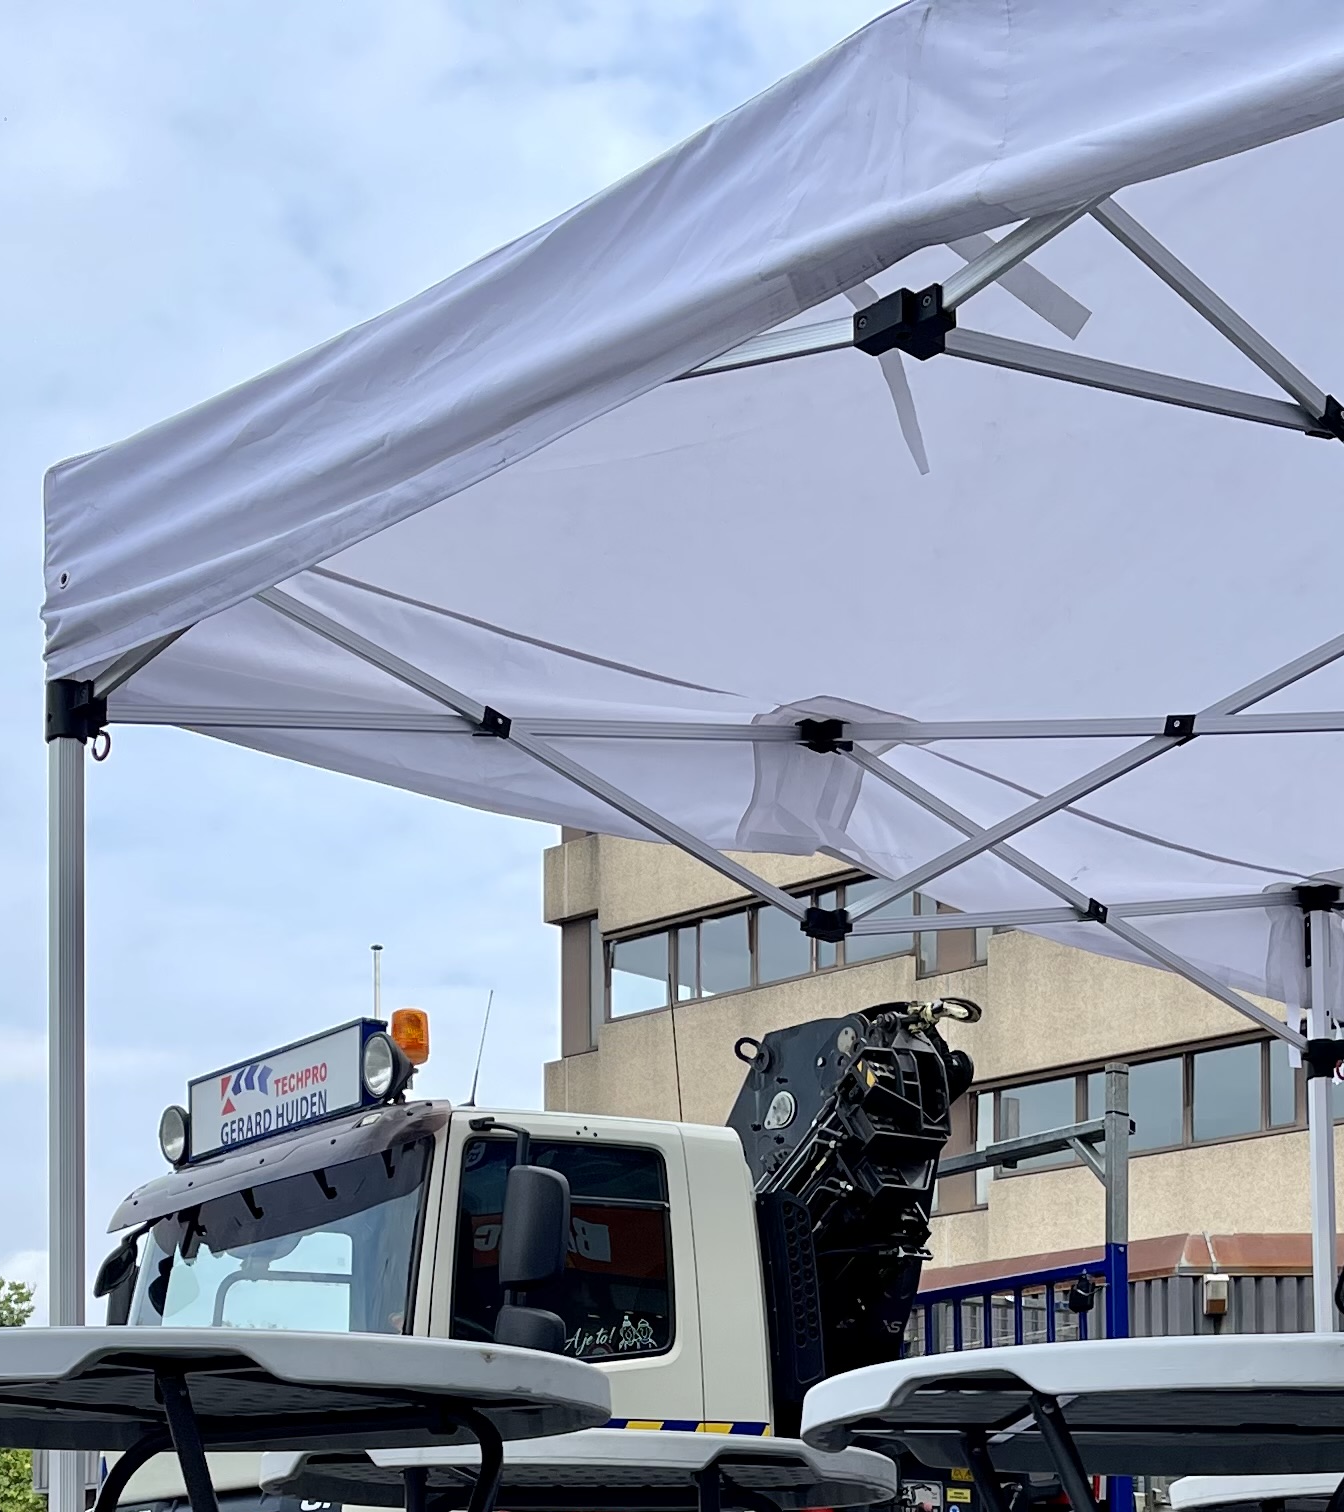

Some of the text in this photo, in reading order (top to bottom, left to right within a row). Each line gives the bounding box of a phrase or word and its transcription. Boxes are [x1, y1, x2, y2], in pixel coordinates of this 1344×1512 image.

[273, 1062, 328, 1097] TECHPRO
[220, 1089, 328, 1145] GERARD HUIDEN
